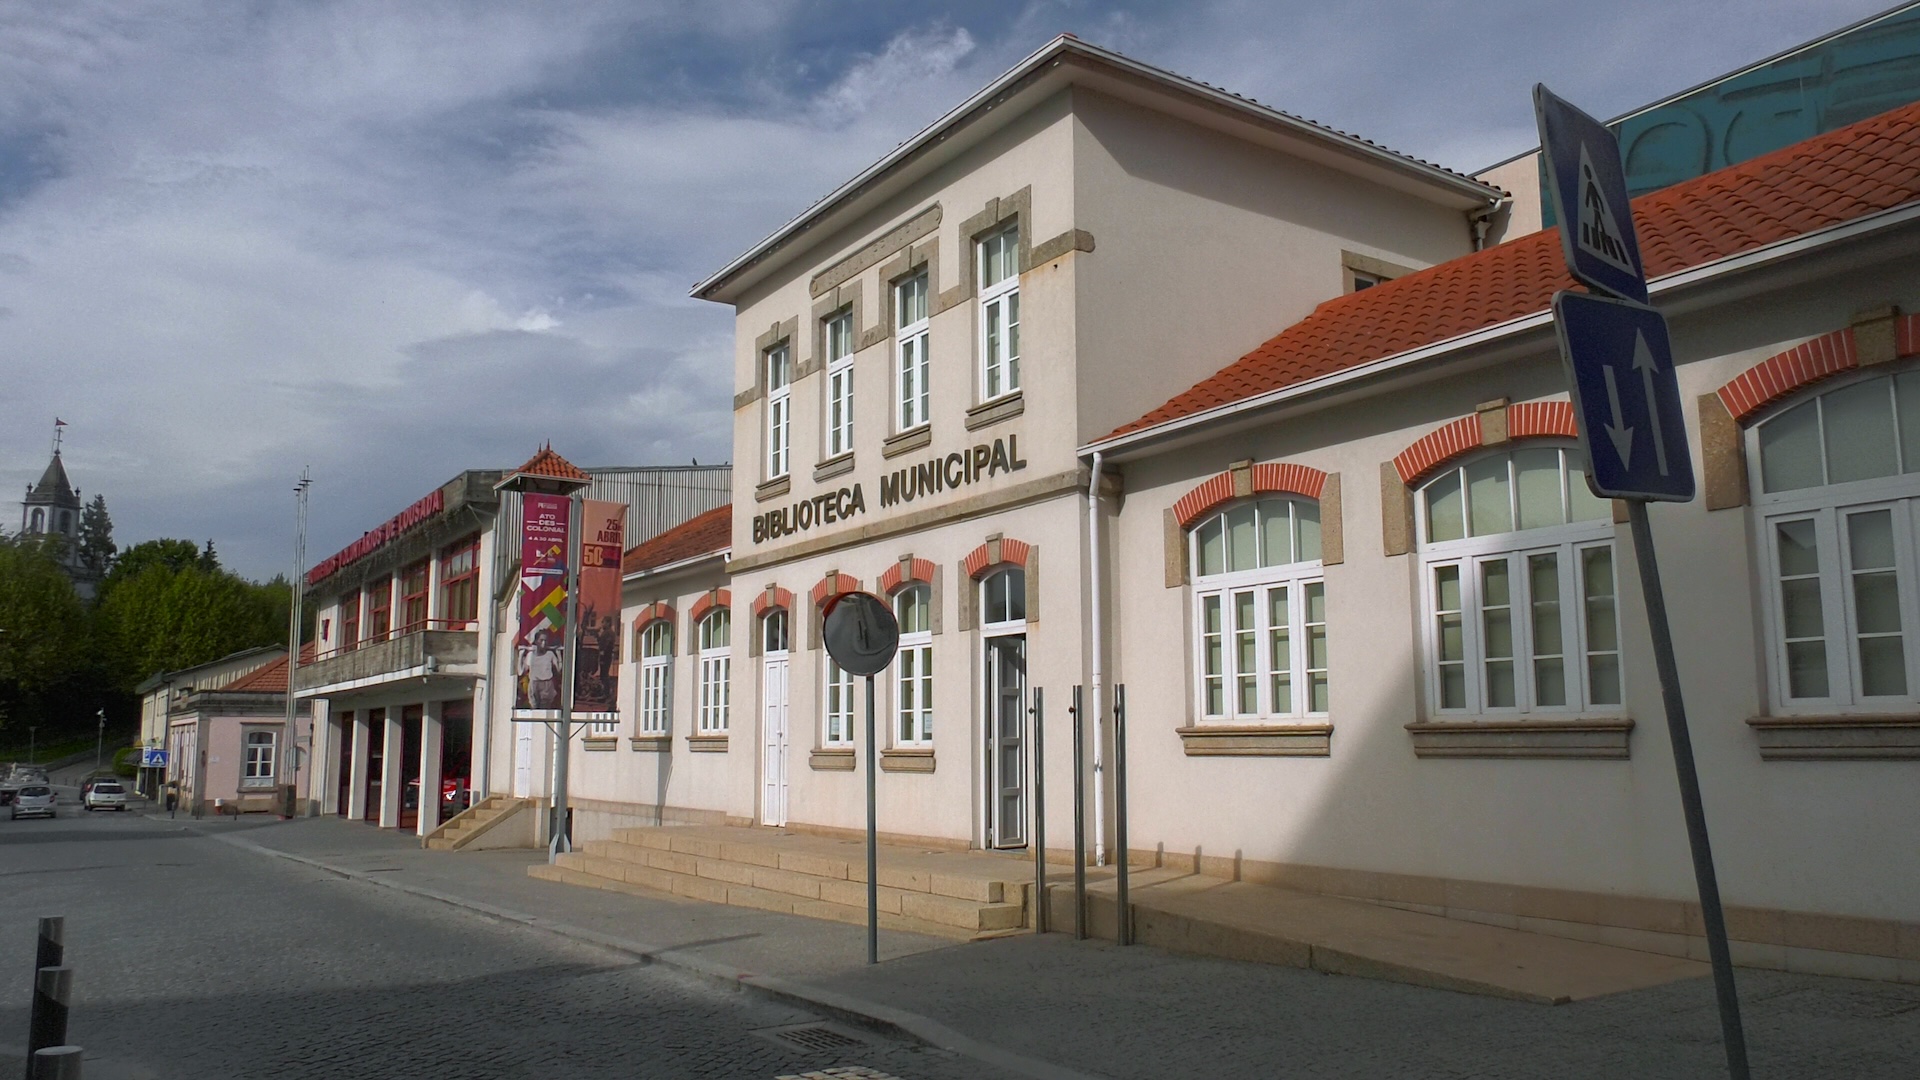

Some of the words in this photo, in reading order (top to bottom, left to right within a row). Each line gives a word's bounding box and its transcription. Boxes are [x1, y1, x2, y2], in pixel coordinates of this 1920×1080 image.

[752, 483, 865, 544] BIBLIOTECA
[880, 434, 1027, 508] MUNICIPAL
[398, 488, 443, 532] LOUSADA
[526, 525, 565, 533] COLONIAL
[606, 518, 618, 531] 25
[597, 530, 622, 544] ABRIL
[583, 545, 604, 566] 50
